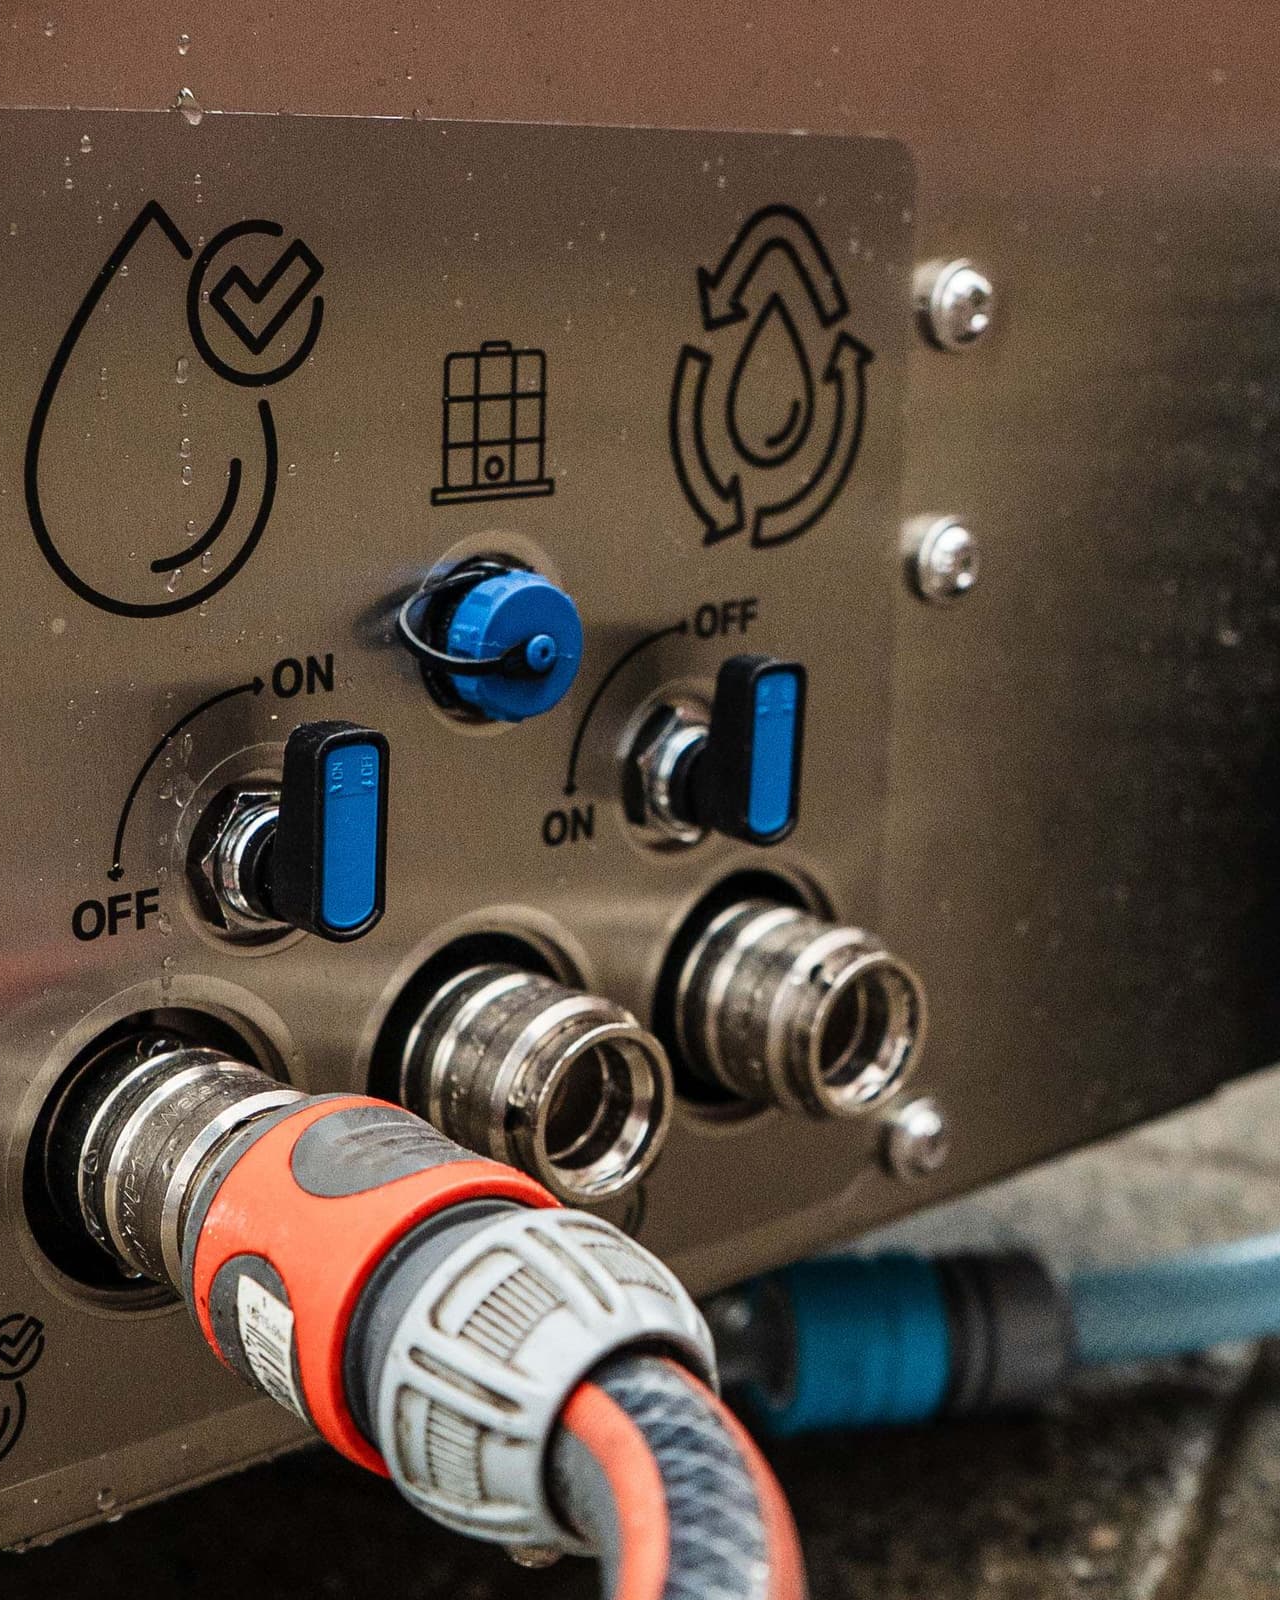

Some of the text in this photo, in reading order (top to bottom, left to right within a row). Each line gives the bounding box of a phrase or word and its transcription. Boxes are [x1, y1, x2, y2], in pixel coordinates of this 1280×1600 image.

[694, 595, 758, 638] OFF
[272, 653, 334, 699] ON
[542, 803, 594, 847] ON
[71, 887, 160, 941] OFF
